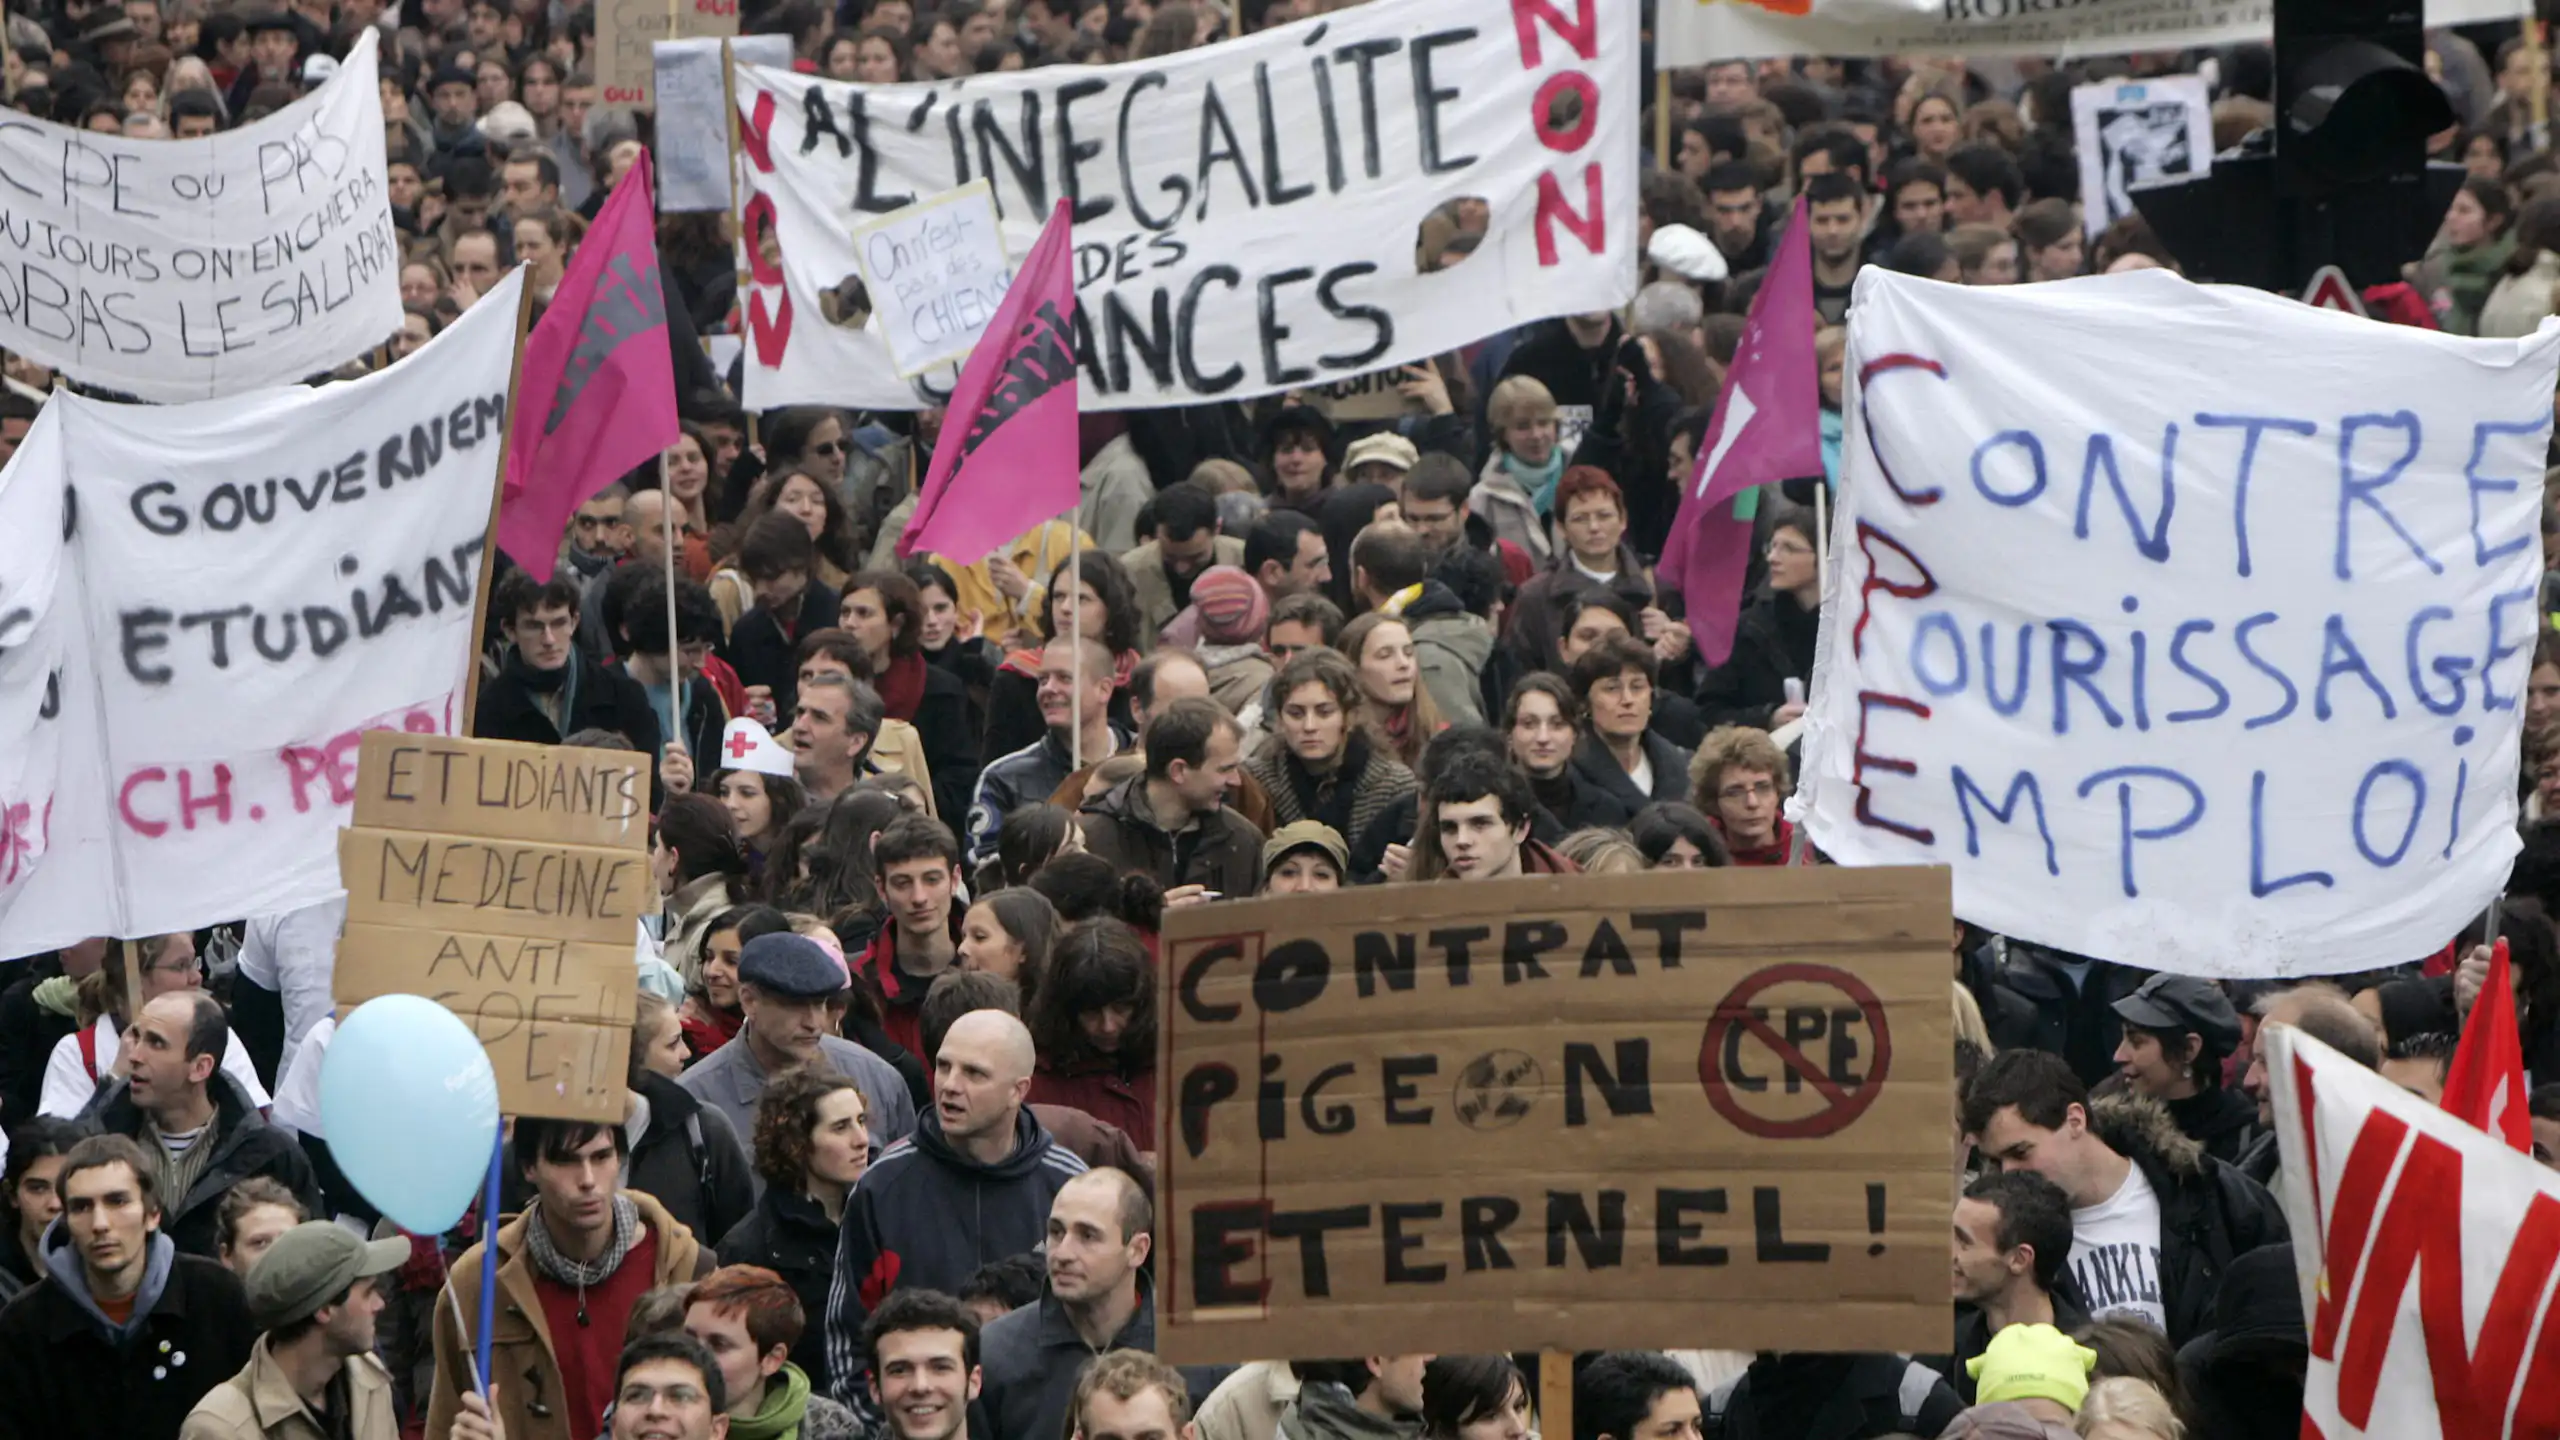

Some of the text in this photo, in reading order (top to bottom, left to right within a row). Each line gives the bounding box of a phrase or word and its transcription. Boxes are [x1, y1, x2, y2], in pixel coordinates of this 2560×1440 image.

[1073, 230, 1189, 289] DES
[1861, 353, 2551, 582] CONTRE
[427, 935, 568, 985] ANTI
[1180, 911, 1706, 1023] CONTRAT
